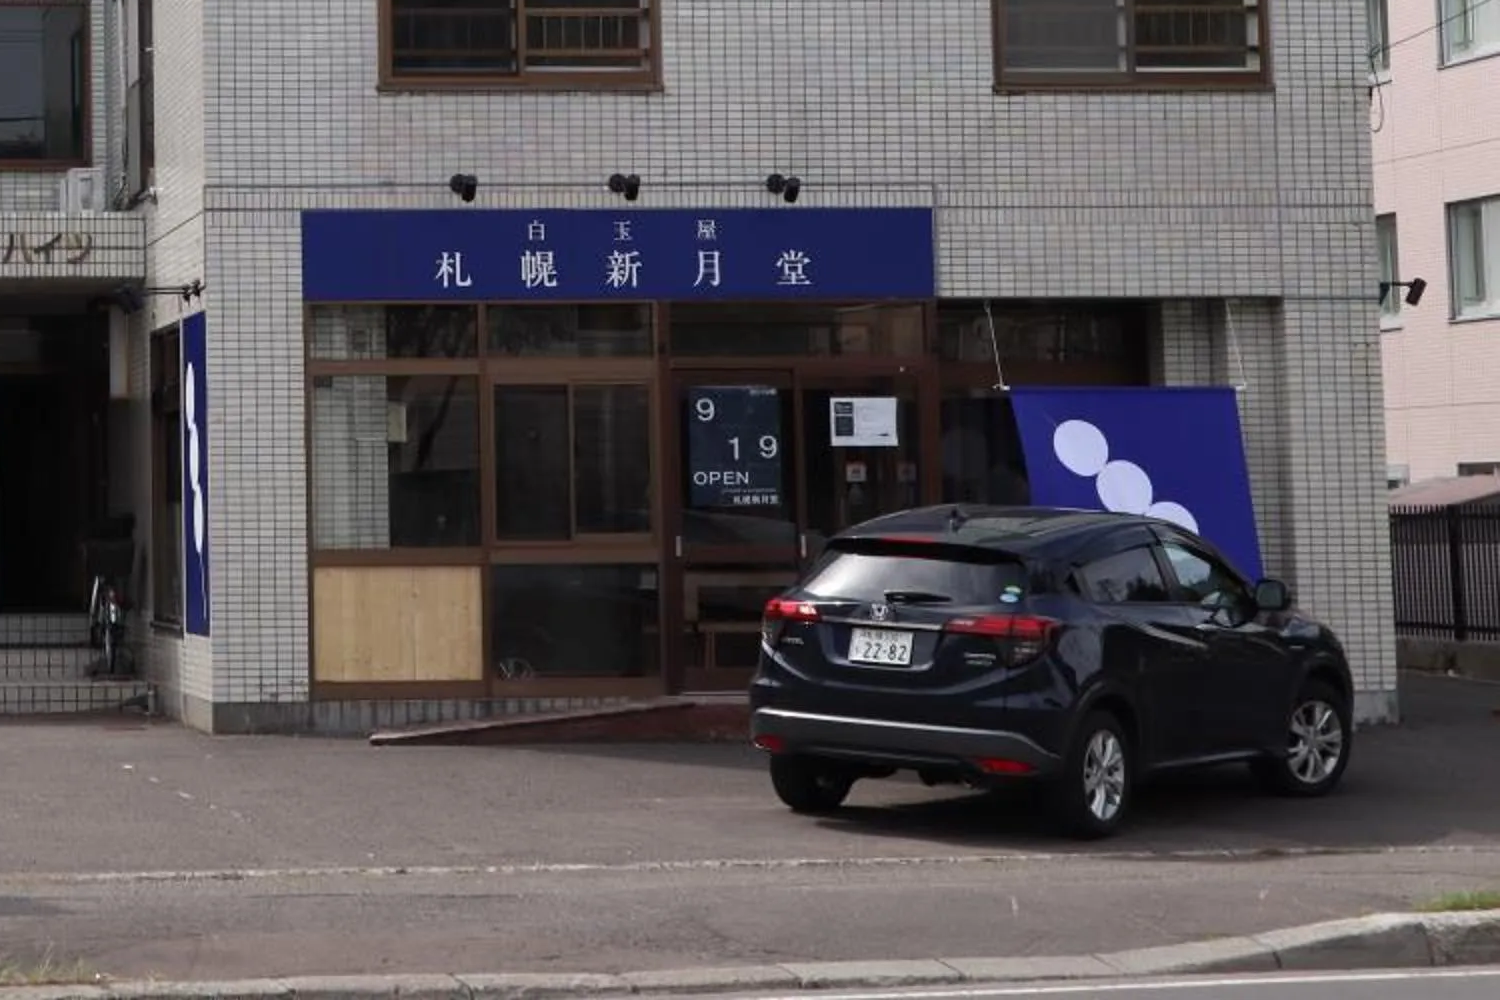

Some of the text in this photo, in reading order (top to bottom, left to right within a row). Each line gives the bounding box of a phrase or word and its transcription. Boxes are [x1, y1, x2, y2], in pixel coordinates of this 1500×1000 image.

[528, 219, 717, 241] 白玉屋
[435, 249, 812, 289] 札幌新月堂
[695, 398, 716, 422] 9
[693, 471, 749, 485] OPEN
[862, 641, 908, 661] 22-82
